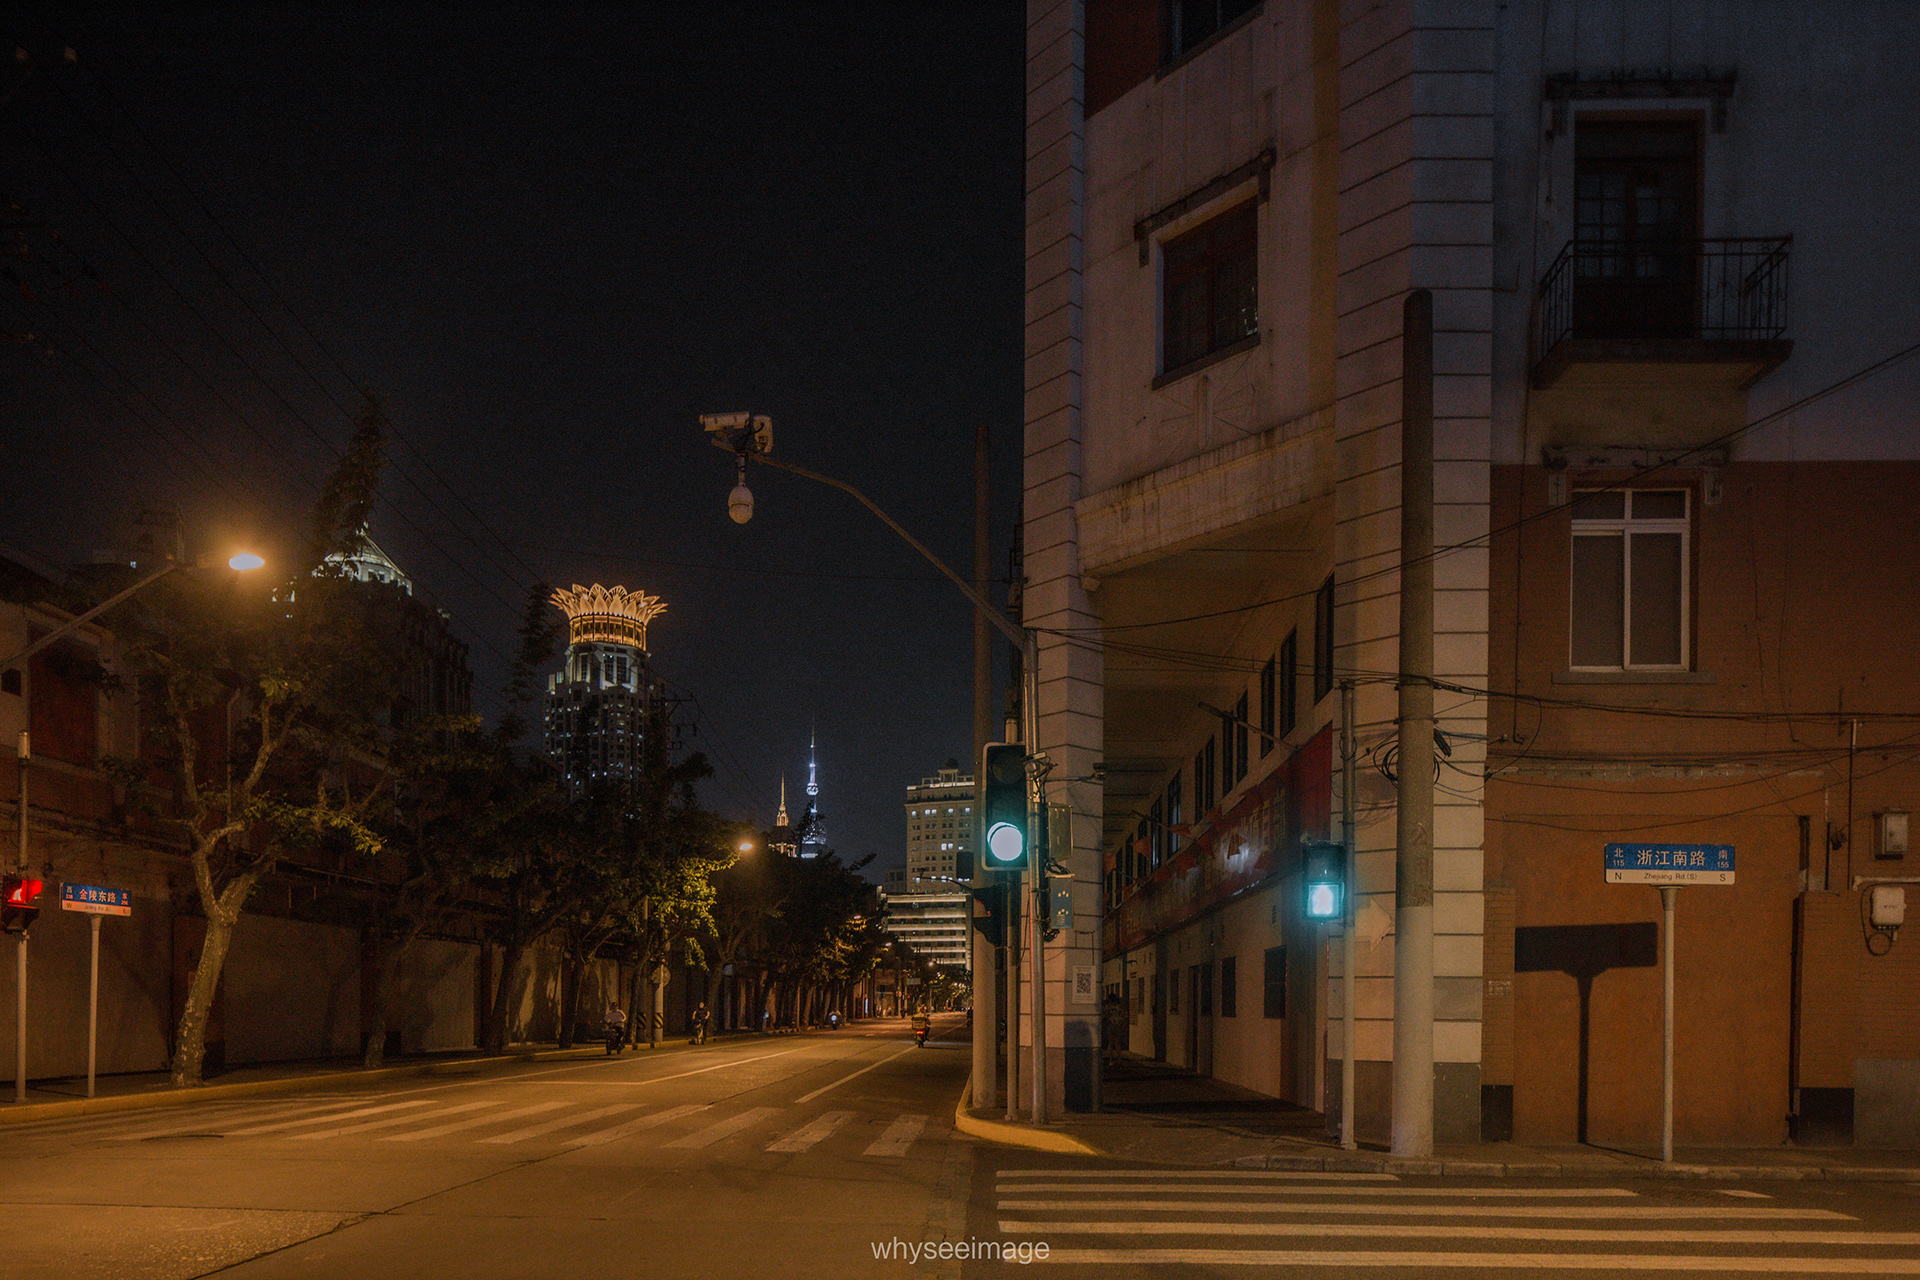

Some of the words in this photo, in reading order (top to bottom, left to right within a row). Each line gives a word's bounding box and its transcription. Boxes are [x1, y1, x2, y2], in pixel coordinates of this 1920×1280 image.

[1613, 847, 1624, 858] 北
[1718, 849, 1728, 860] 南
[1637, 849, 1706, 866] 浙江南路
[1612, 859, 1625, 867] 115
[1716, 861, 1730, 869] 155
[1614, 872, 1622, 880] N
[1643, 872, 1673, 881] Zhejiang
[1719, 873, 1726, 882] S
[79, 888, 117, 903] 金陵东路
